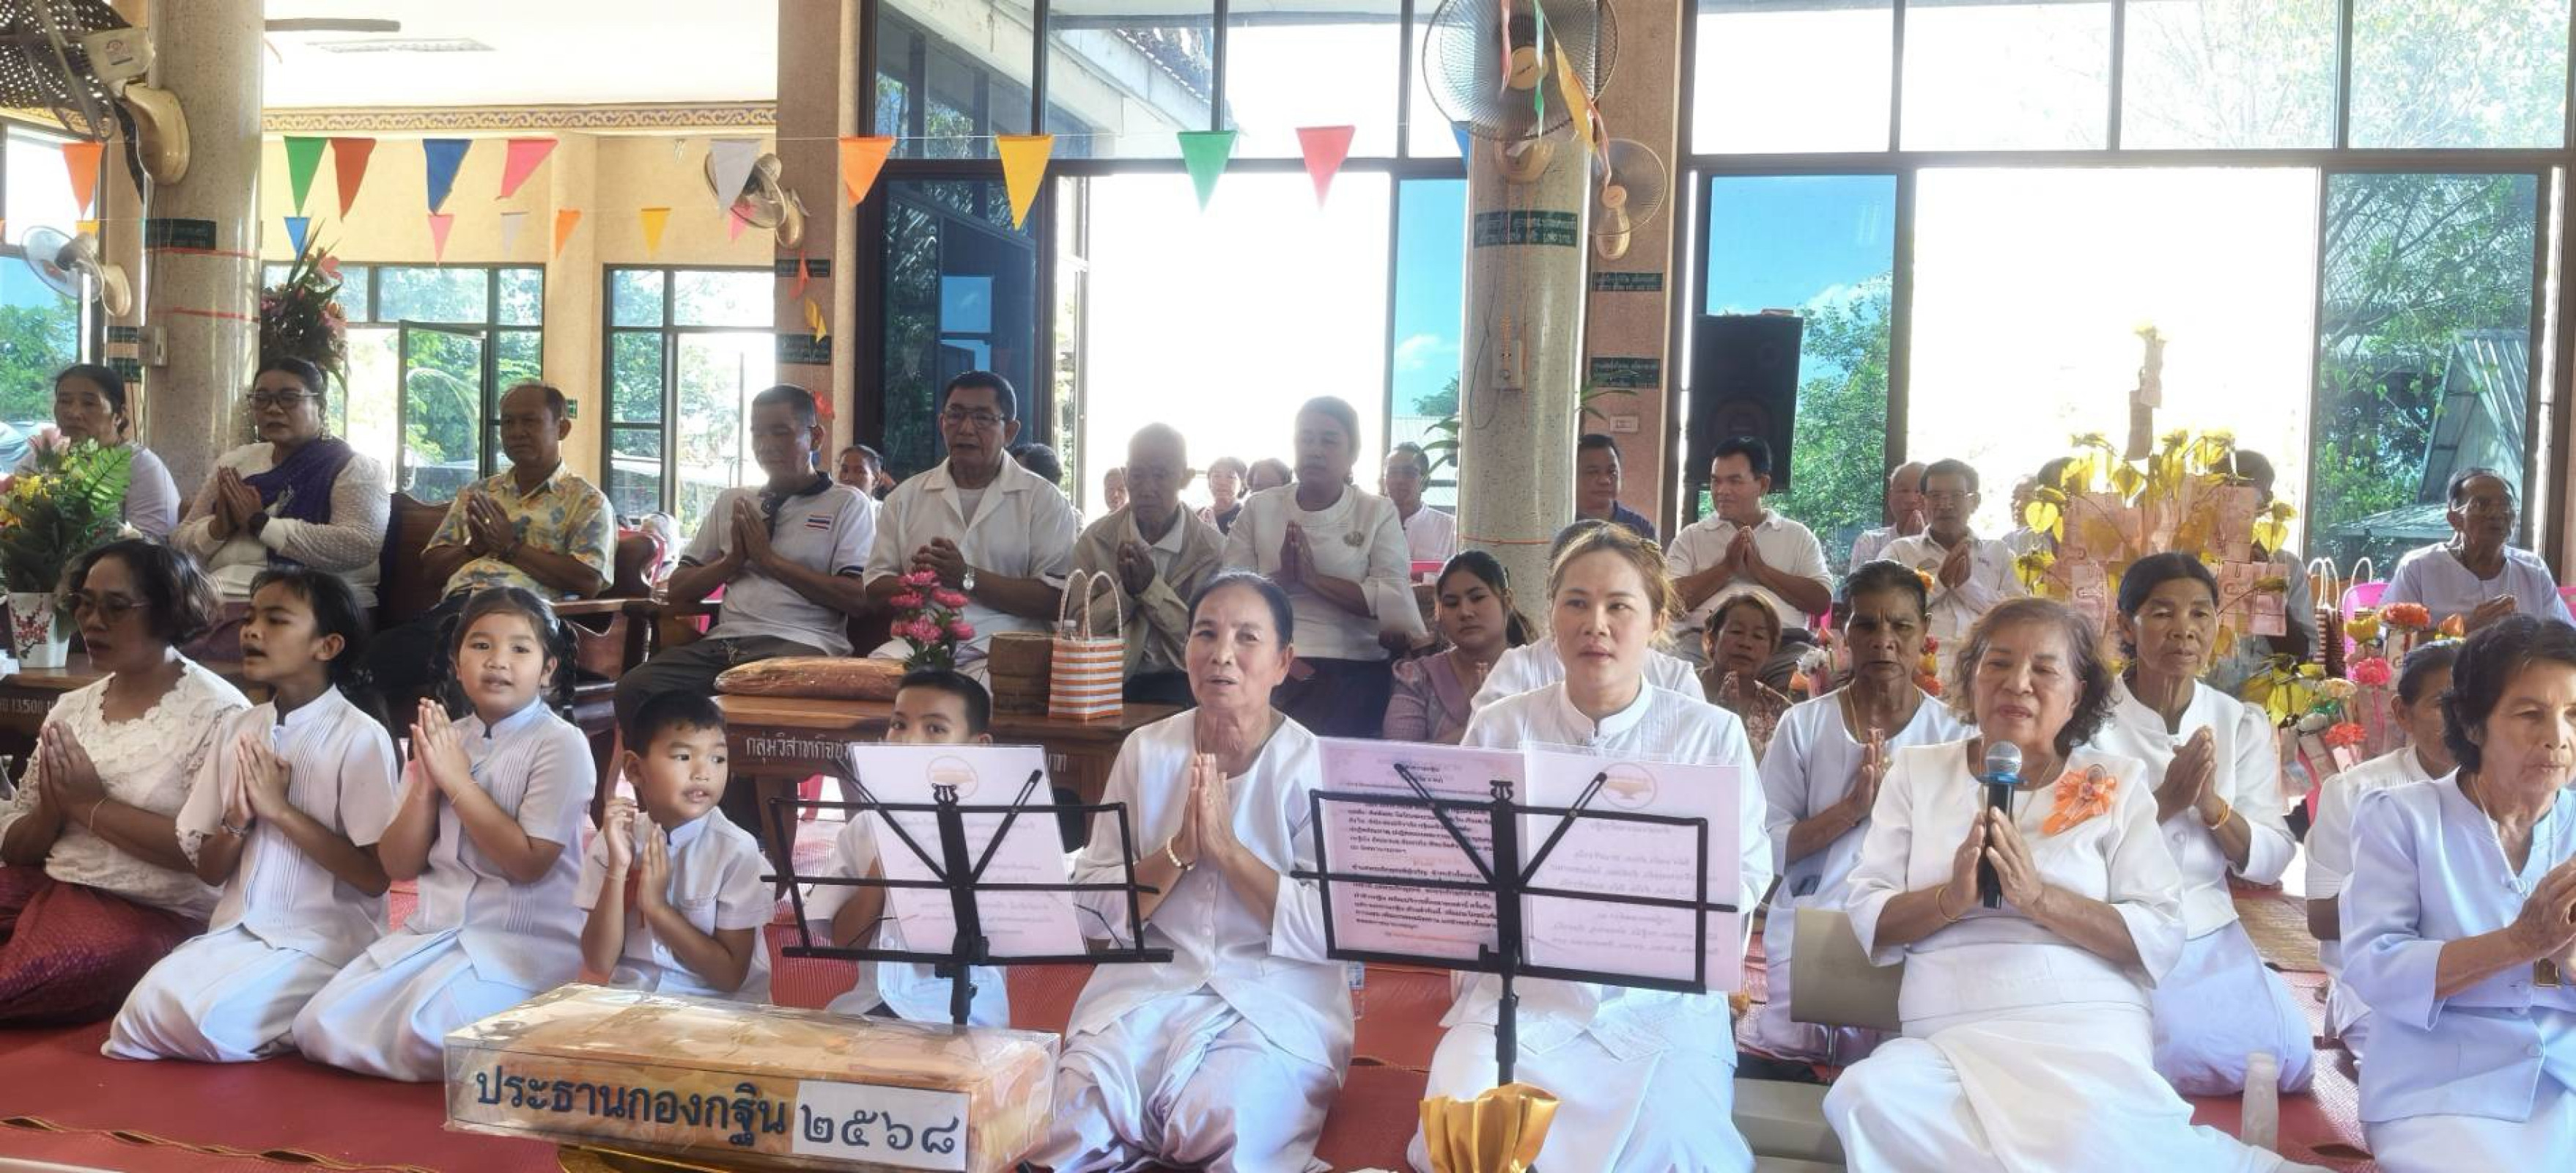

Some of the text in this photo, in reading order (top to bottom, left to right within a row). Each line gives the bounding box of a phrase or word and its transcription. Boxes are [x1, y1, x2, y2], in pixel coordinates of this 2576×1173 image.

[476, 1065, 960, 1154] ประธานกองกฐิน ๒๕๖๘
